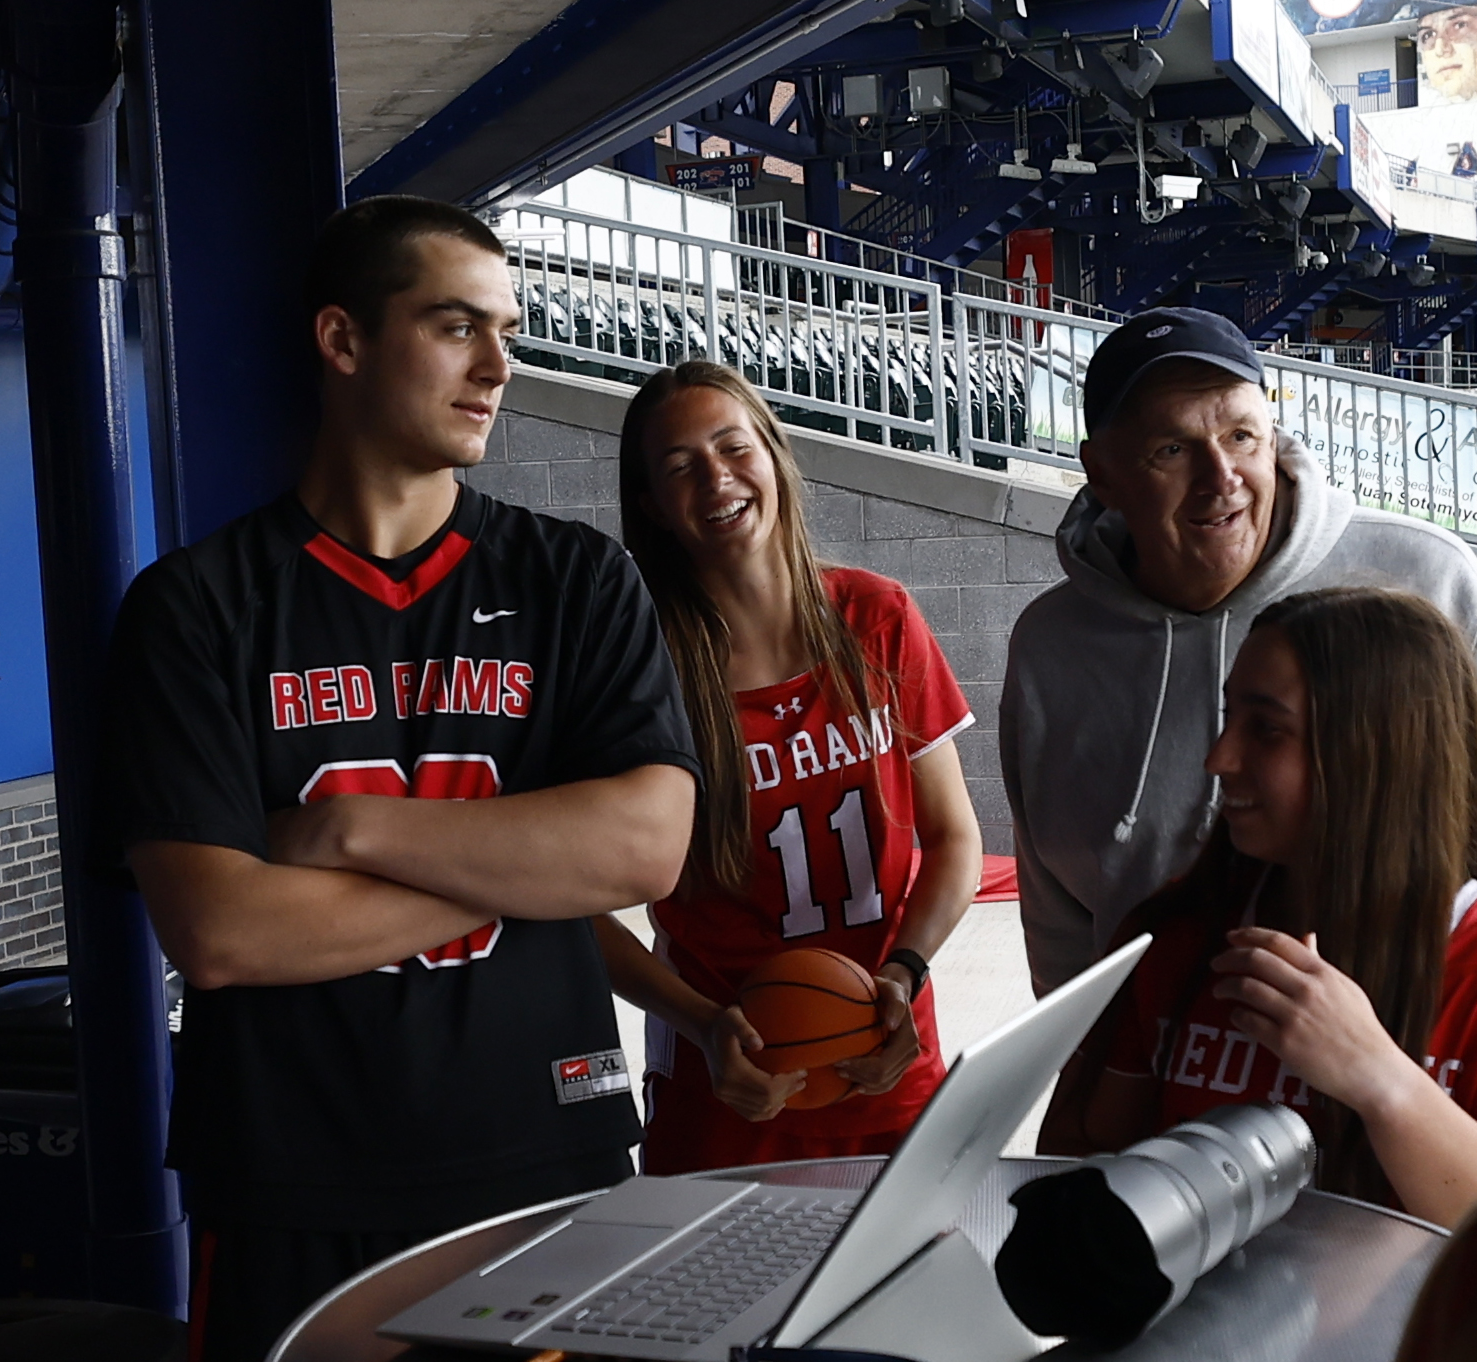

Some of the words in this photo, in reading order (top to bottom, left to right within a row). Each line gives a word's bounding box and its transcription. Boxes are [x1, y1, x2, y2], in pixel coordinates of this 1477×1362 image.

[676, 168, 697, 180] 202
[729, 163, 749, 175] 201
[1415, 408, 1449, 463] &
[270, 664, 377, 730] RED
[392, 655, 535, 720] RAMS
[768, 789, 883, 939] 11
[599, 1058, 620, 1072] XL
